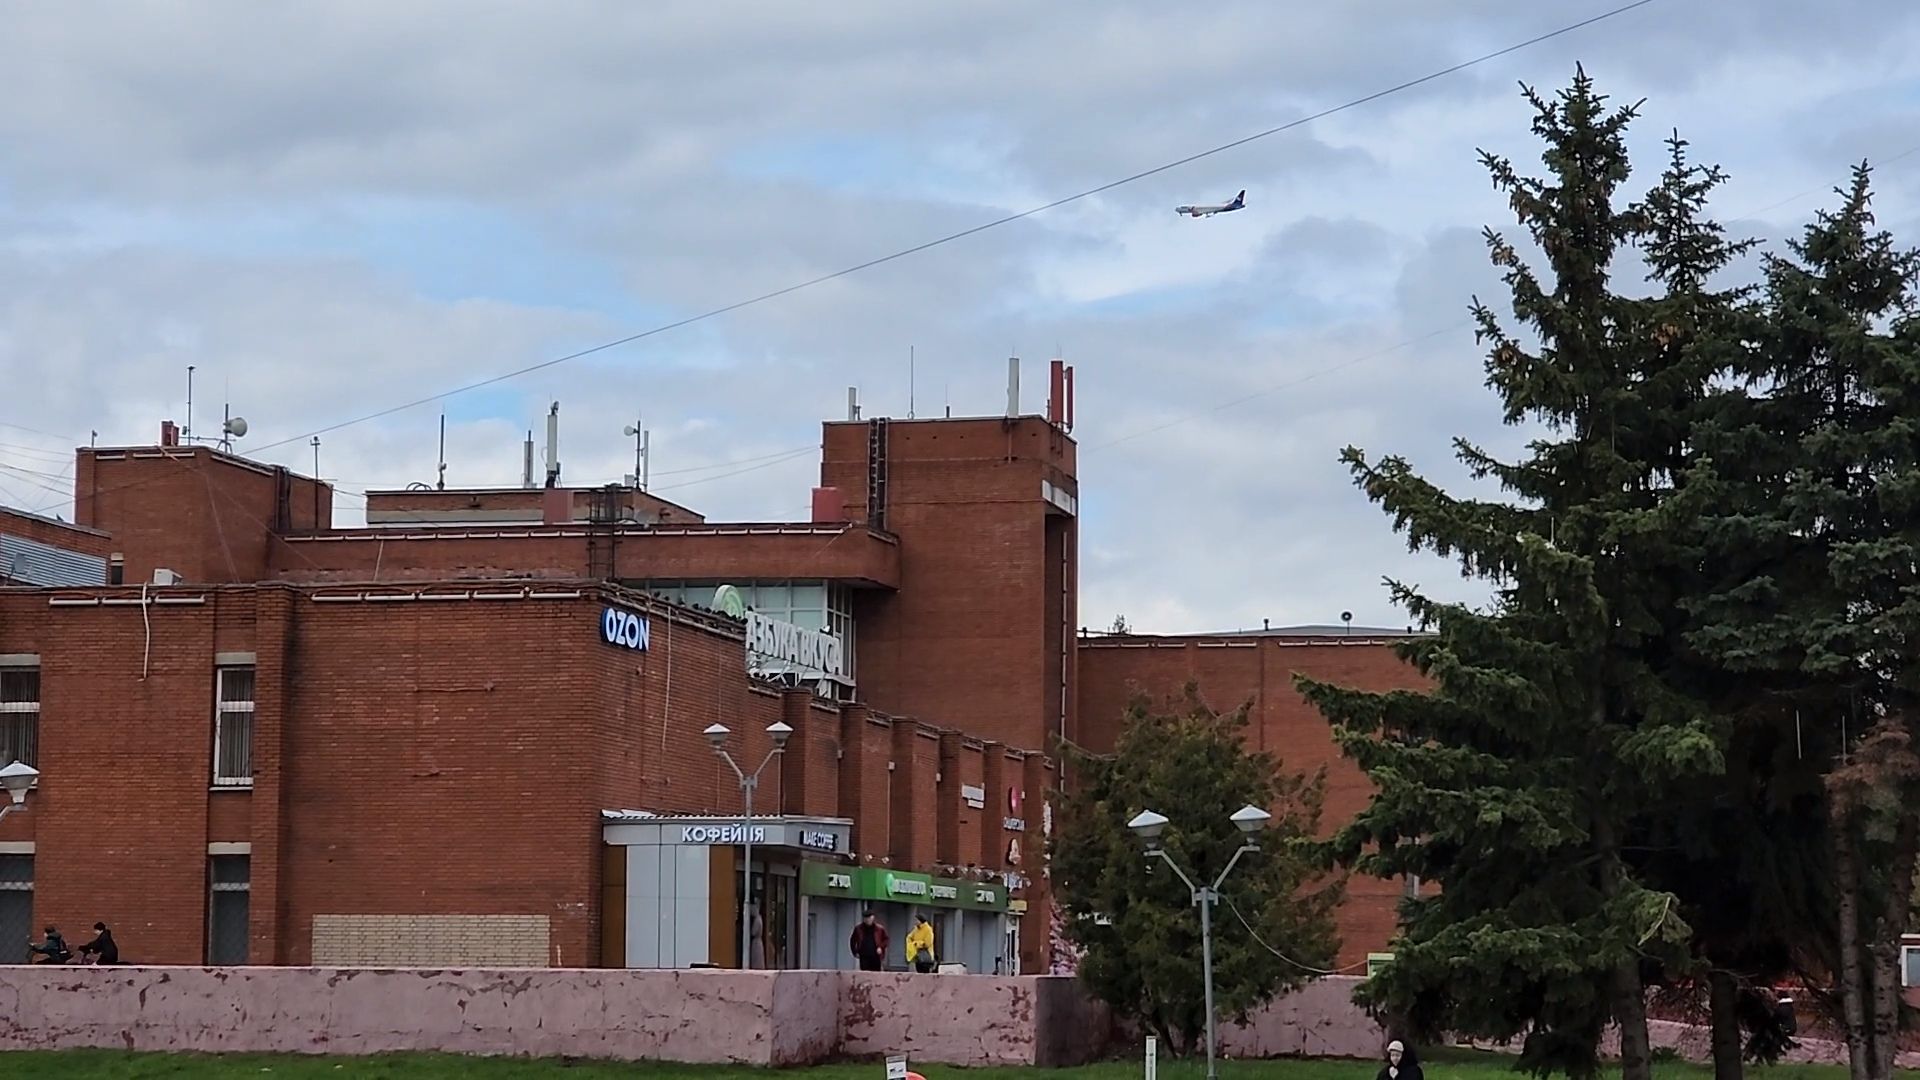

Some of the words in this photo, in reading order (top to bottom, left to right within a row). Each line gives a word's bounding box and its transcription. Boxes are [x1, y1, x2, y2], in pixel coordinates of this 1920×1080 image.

[605, 607, 649, 651] OZON
[746, 611, 799, 663] АЗБУКА
[799, 627, 843, 676] ВКУСА
